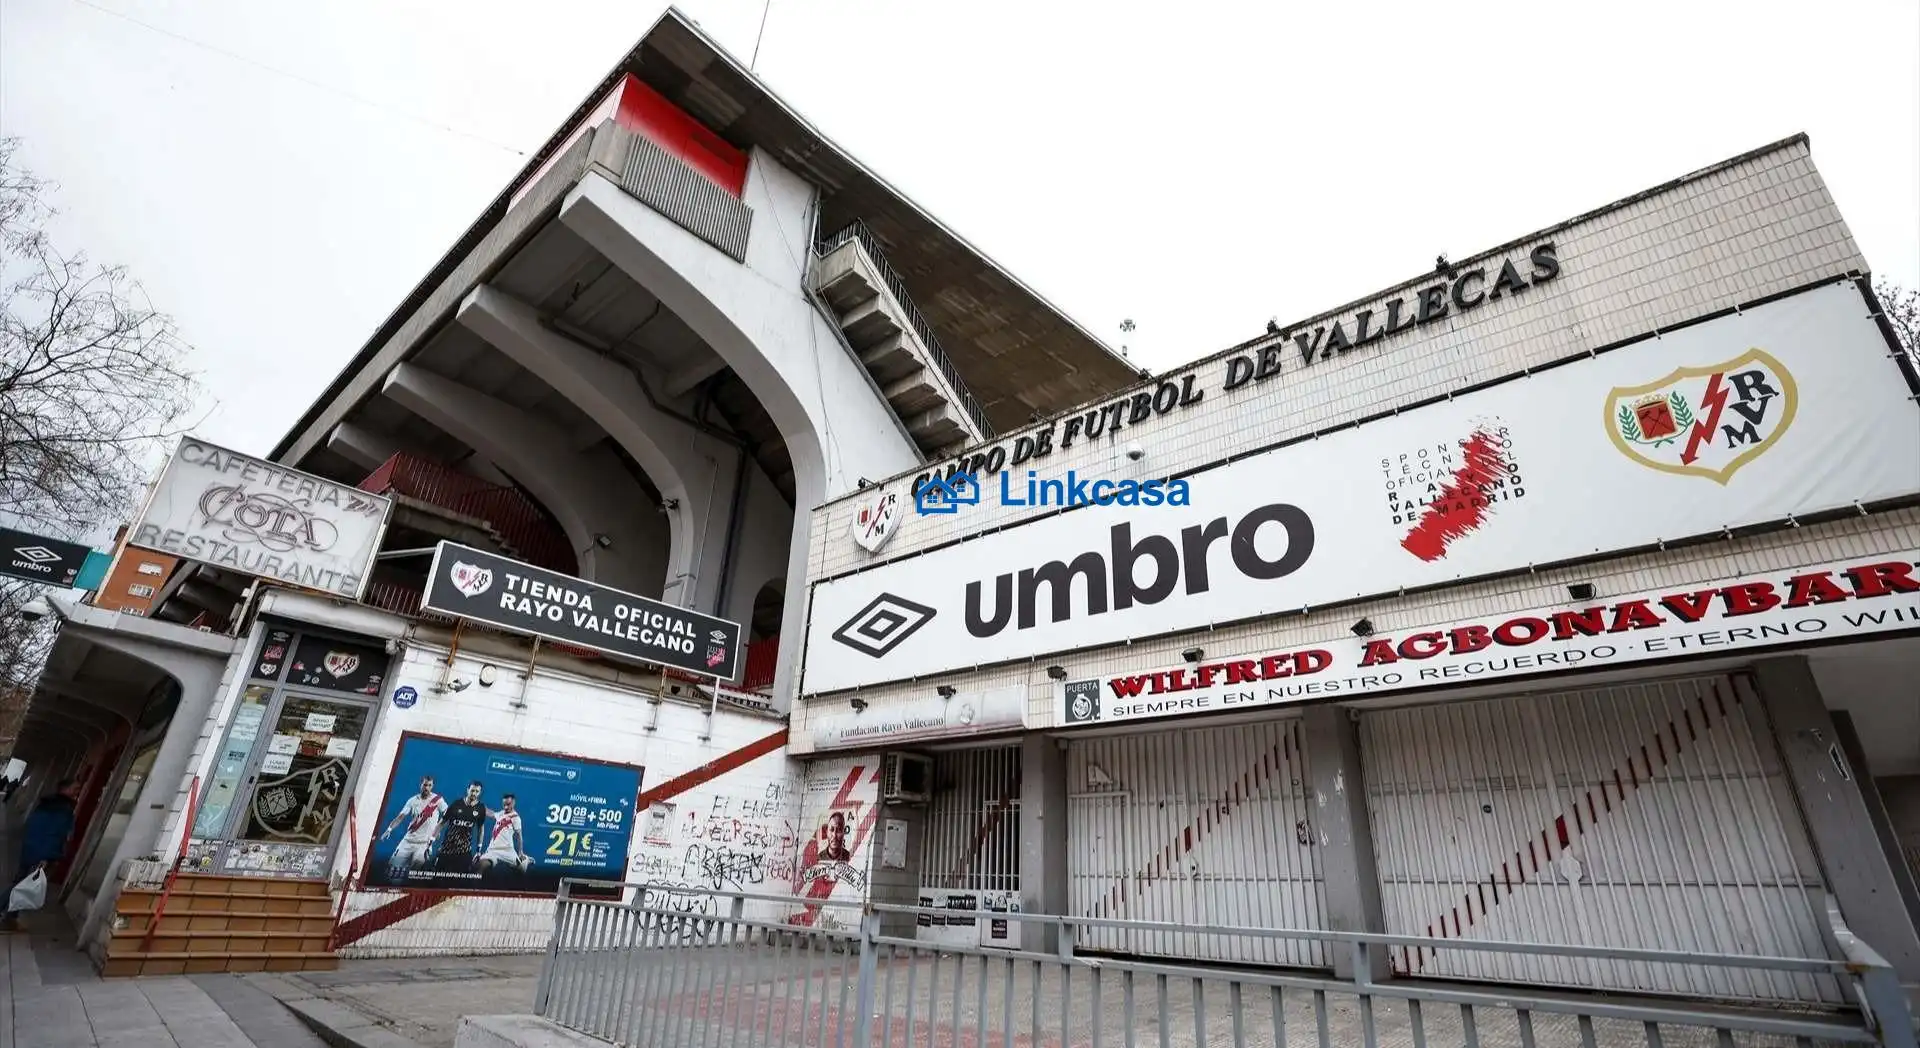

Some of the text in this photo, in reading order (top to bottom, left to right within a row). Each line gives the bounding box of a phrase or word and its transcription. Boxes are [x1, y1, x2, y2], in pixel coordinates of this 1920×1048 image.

[1011, 418, 1054, 465] DE
[1063, 375, 1203, 449] FUTBOL
[1223, 344, 1281, 390] DE
[1294, 242, 1560, 366] VALLECAS
[180, 443, 341, 508] CAFETERIA
[1393, 487, 1526, 525] DE MADRID
[12, 560, 52, 573] umbro
[138, 523, 360, 596] RESTAURANTE
[964, 503, 1316, 639] umbro
[500, 593, 563, 622] RAYO
[573, 610, 695, 654] VALLECANO
[505, 573, 697, 639] TIENDA OFICIAL
[1108, 561, 1920, 699] WILFRED AGBONAVBAR
[1066, 682, 1098, 693] PUERTA
[1113, 696, 1210, 717] SIEMPRE
[1223, 691, 1255, 704] EN
[1269, 672, 1402, 699] NUESTRO
[1420, 645, 1616, 680] RECUERDO
[1644, 618, 1828, 652] ETERNO
[397, 691, 415, 702] ADT
[881, 722, 902, 733] Rayo
[904, 717, 945, 730] Vallecano
[492, 762, 515, 770] DIGI
[546, 804, 572, 824] 30
[573, 806, 587, 816] GB
[598, 808, 622, 823] 500
[546, 830, 594, 857] 21 €
